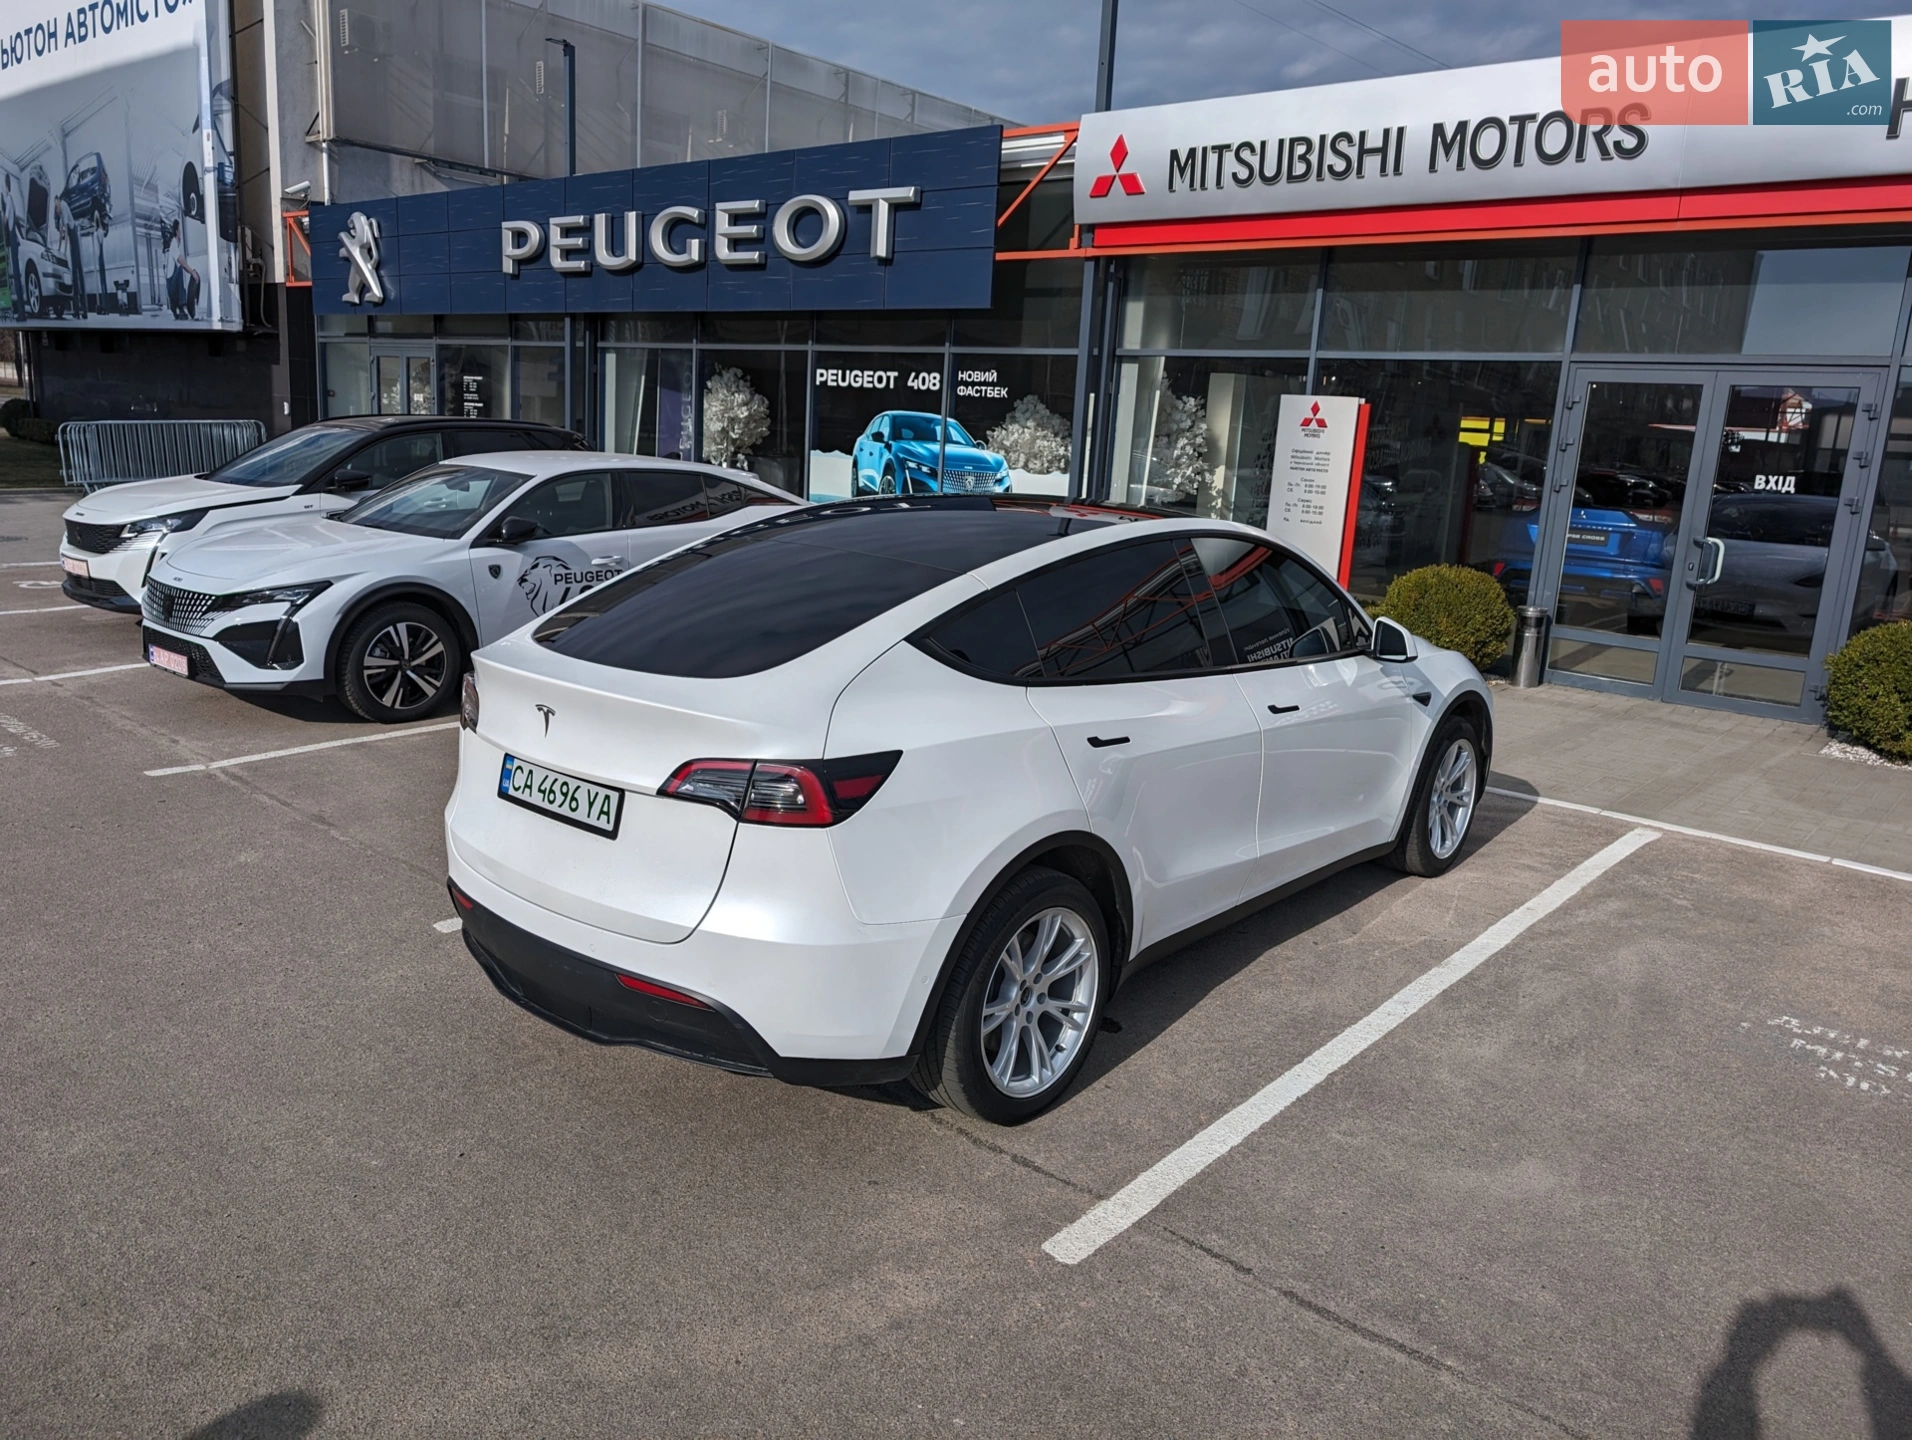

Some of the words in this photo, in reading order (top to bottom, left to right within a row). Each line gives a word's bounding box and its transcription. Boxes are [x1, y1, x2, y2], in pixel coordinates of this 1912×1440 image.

[1168, 124, 1408, 194] MITSUBISHI
[1428, 102, 1651, 174] MOTORS
[501, 185, 921, 277] PEUGEOT
[815, 368, 898, 388] PEUGEOT
[906, 372, 941, 390] 408
[957, 369, 998, 383] НОВИЙ
[956, 385, 1009, 398] ФАСТБЕК
[1753, 474, 1796, 494] ВХІД
[502, 778, 510, 788] UA
[511, 765, 534, 798] CA
[537, 775, 582, 813] 4696
[586, 788, 612, 825] YA
